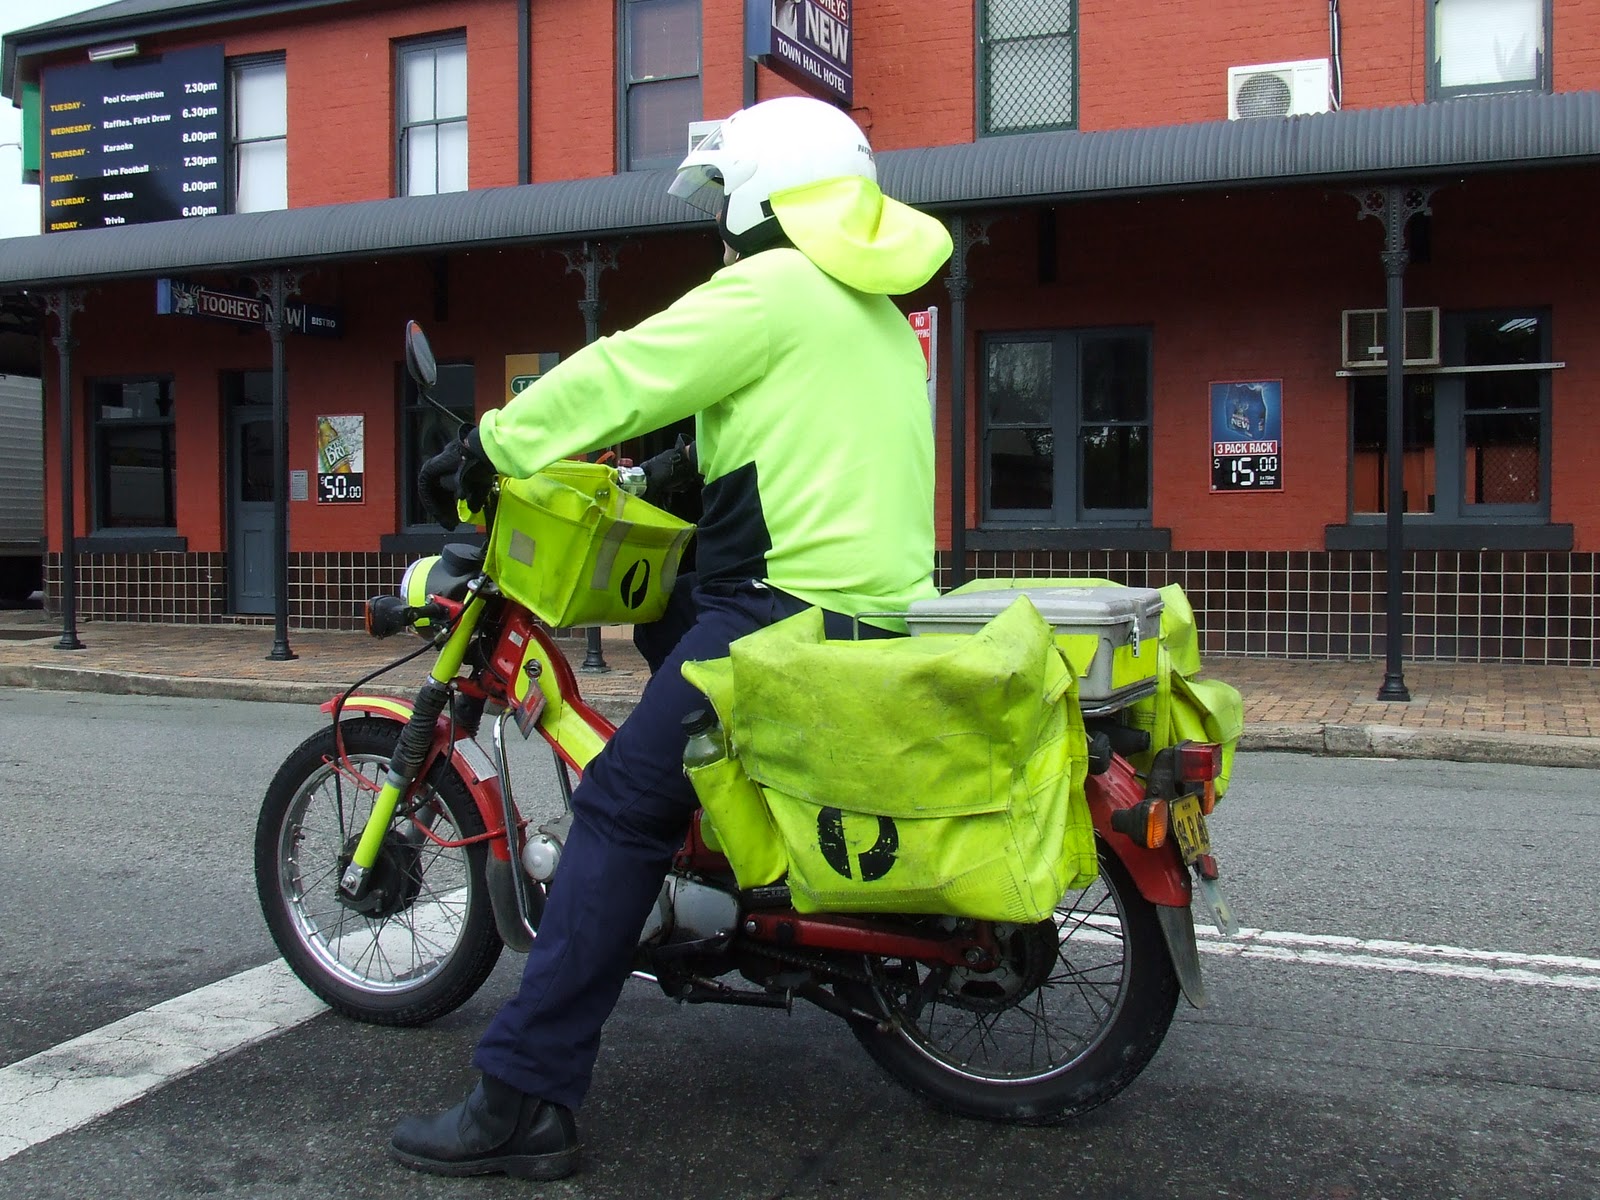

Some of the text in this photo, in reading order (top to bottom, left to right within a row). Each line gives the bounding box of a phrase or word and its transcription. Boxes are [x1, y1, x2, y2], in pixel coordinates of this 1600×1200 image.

[804, 0, 849, 65] NEW
[777, 37, 846, 94] TOWN HALL HOTEL
[50, 82, 217, 112] TUESDAY Pool Competition 7.30pm
[50, 124, 92, 136] WEDNESDAY
[133, 116, 151, 125] First
[151, 114, 171, 123] Draw
[182, 107, 218, 119] 6.30pm
[50, 131, 217, 160] THURSDAY Karaoke 8.00pm
[50, 156, 217, 183] FRIDAY Live Football 7.30pm
[50, 181, 217, 207] SATURDAY Karaoke 8.00pm
[51, 205, 217, 231] SUNDAY Trivia 6.00pm
[201, 295, 336, 328] TOOHEYS NW BISTRO
[915, 316, 925, 328] NO
[1217, 442, 1273, 454] 3 PACK RACK
